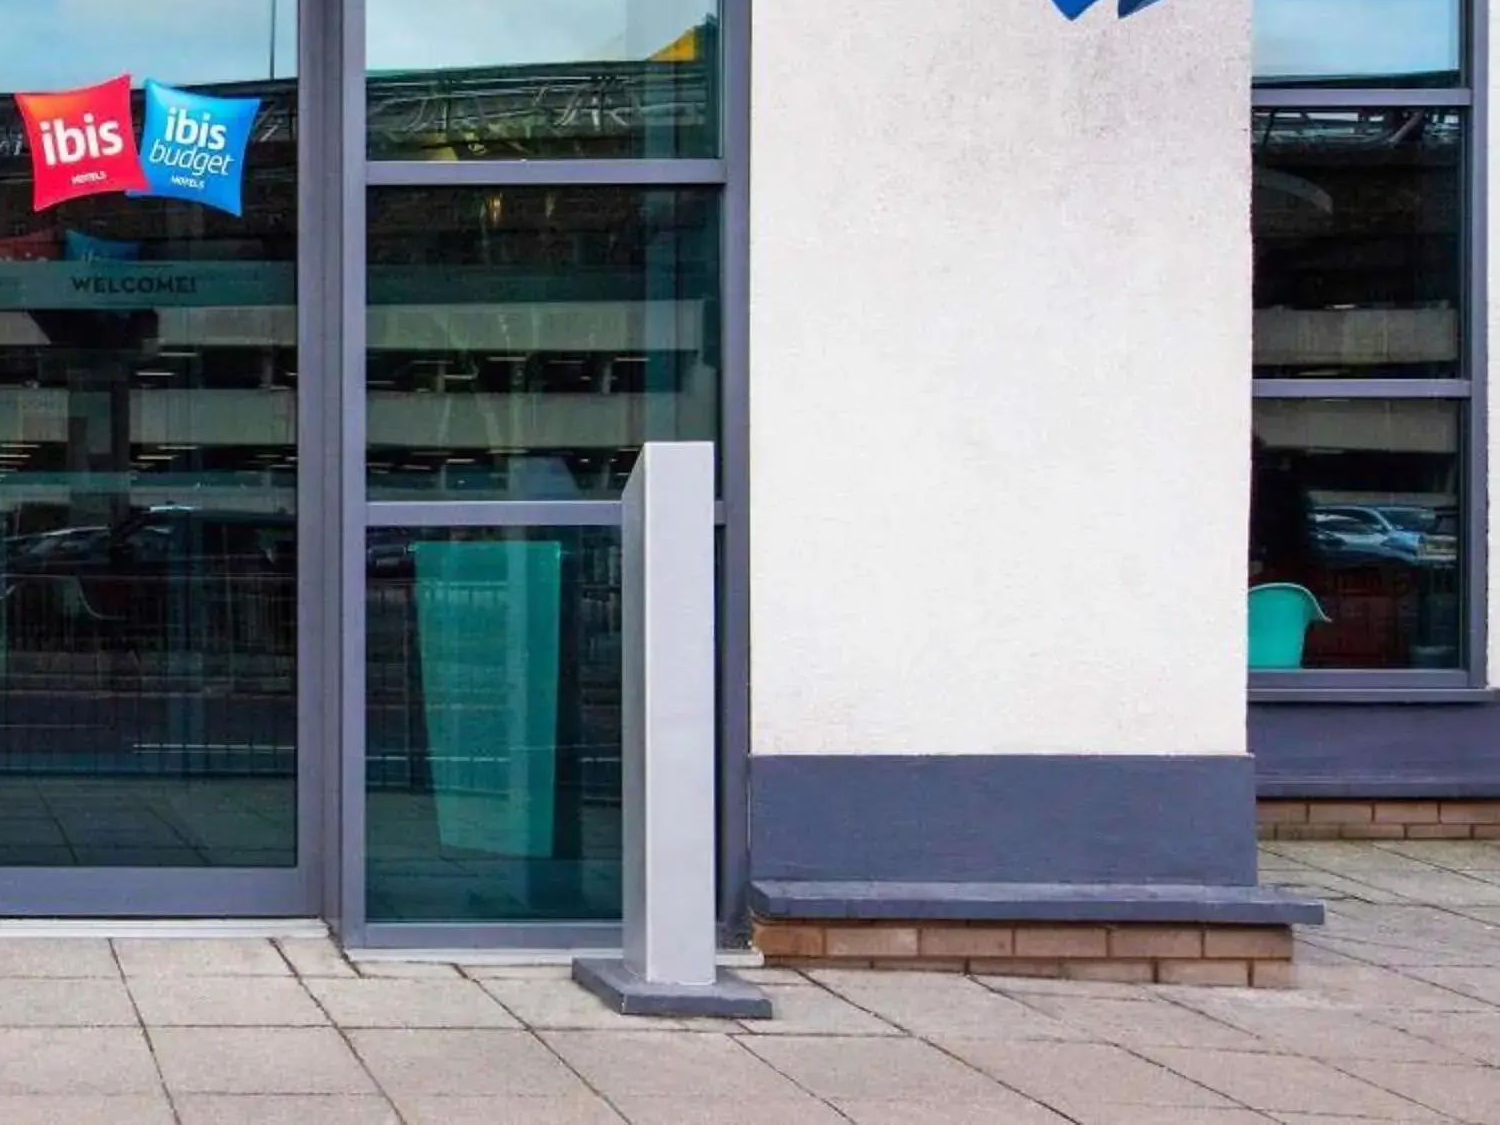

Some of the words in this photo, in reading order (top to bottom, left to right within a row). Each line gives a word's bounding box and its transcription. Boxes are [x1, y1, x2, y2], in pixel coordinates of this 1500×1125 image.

[40, 113, 123, 166] ibis
[165, 106, 227, 150] ibis
[151, 139, 234, 175] budget
[71, 276, 197, 294] WELCOME!
